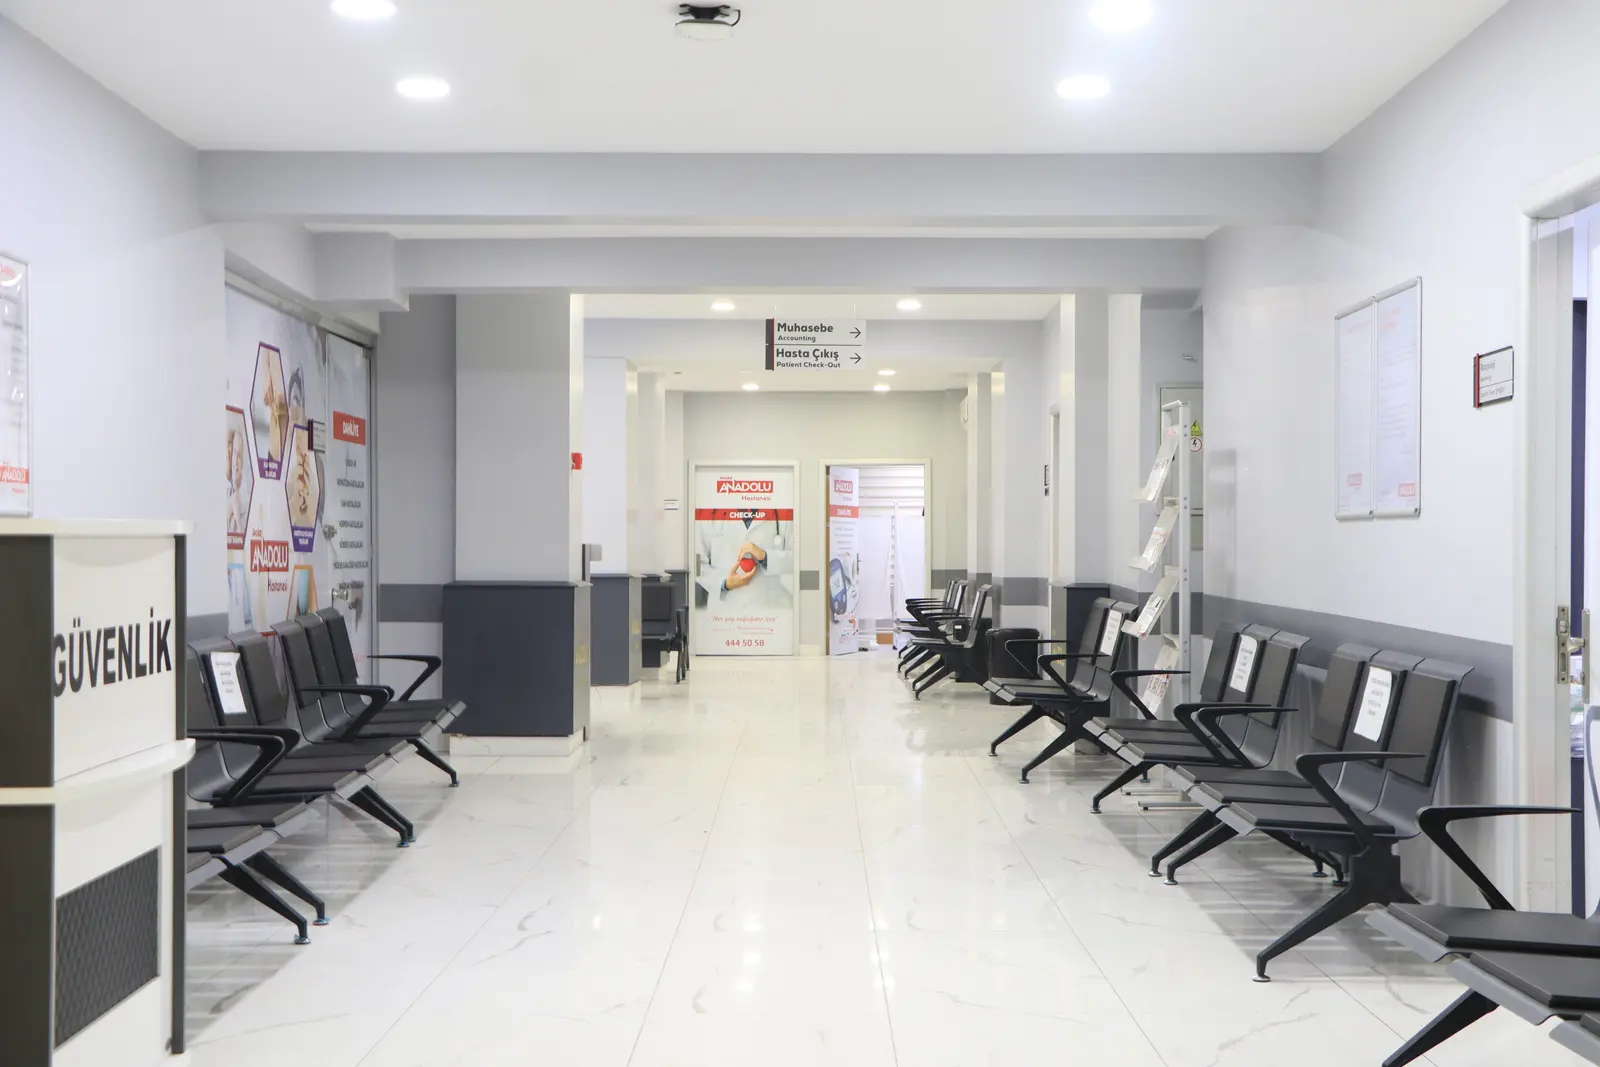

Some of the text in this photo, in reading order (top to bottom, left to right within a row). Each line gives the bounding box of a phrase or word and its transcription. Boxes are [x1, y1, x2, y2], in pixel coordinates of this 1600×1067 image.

[777, 322, 834, 333] Muhasebe
[777, 335, 817, 343] Accounting
[776, 348, 839, 361] Hasta Çıkış
[719, 480, 772, 494] ANADOLU
[729, 511, 766, 519] CHECK-UP
[252, 543, 288, 570] ANADOLU
[725, 639, 765, 647] 444 50 58
[53, 606, 172, 697] GÜVENLİK
